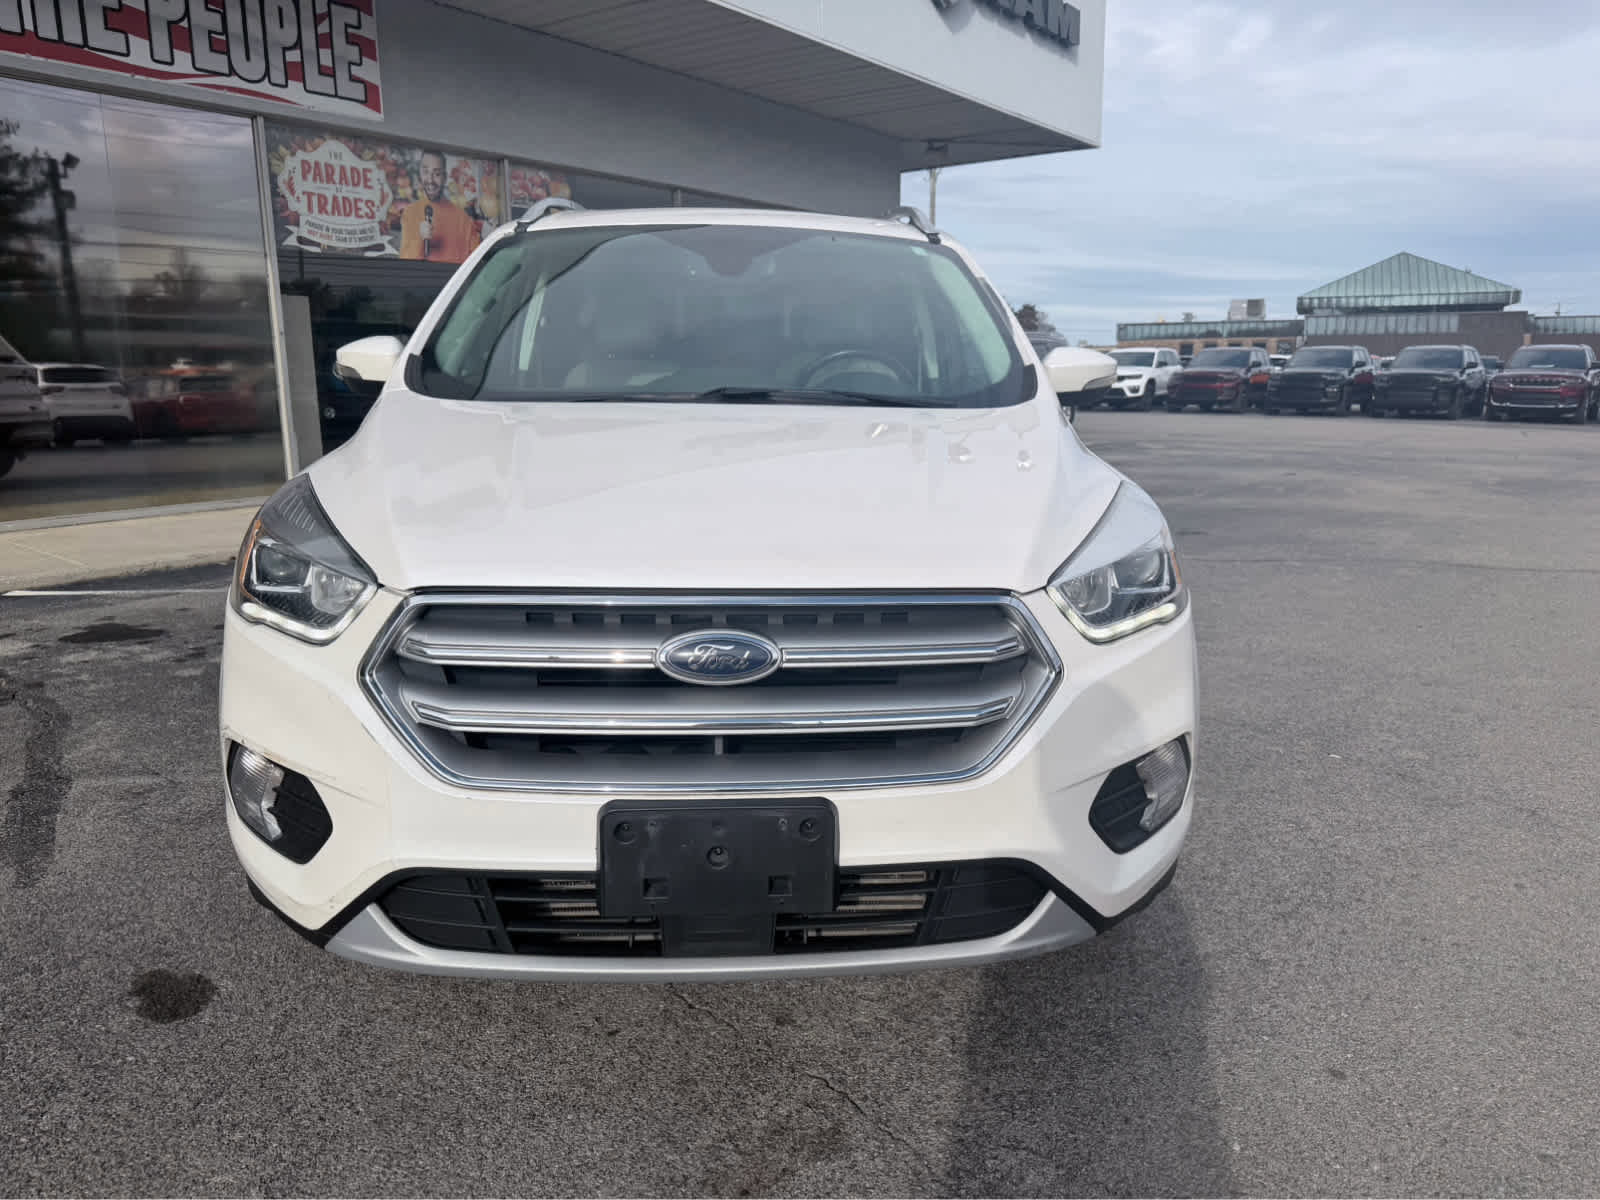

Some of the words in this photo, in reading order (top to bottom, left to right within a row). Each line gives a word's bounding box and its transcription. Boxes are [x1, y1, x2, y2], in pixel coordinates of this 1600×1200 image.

[974, 0, 1081, 46] AM
[146, 0, 368, 103] PEOPLE
[300, 159, 375, 190] PARADE
[301, 191, 377, 220] TRADES
[687, 643, 751, 670] Ford
